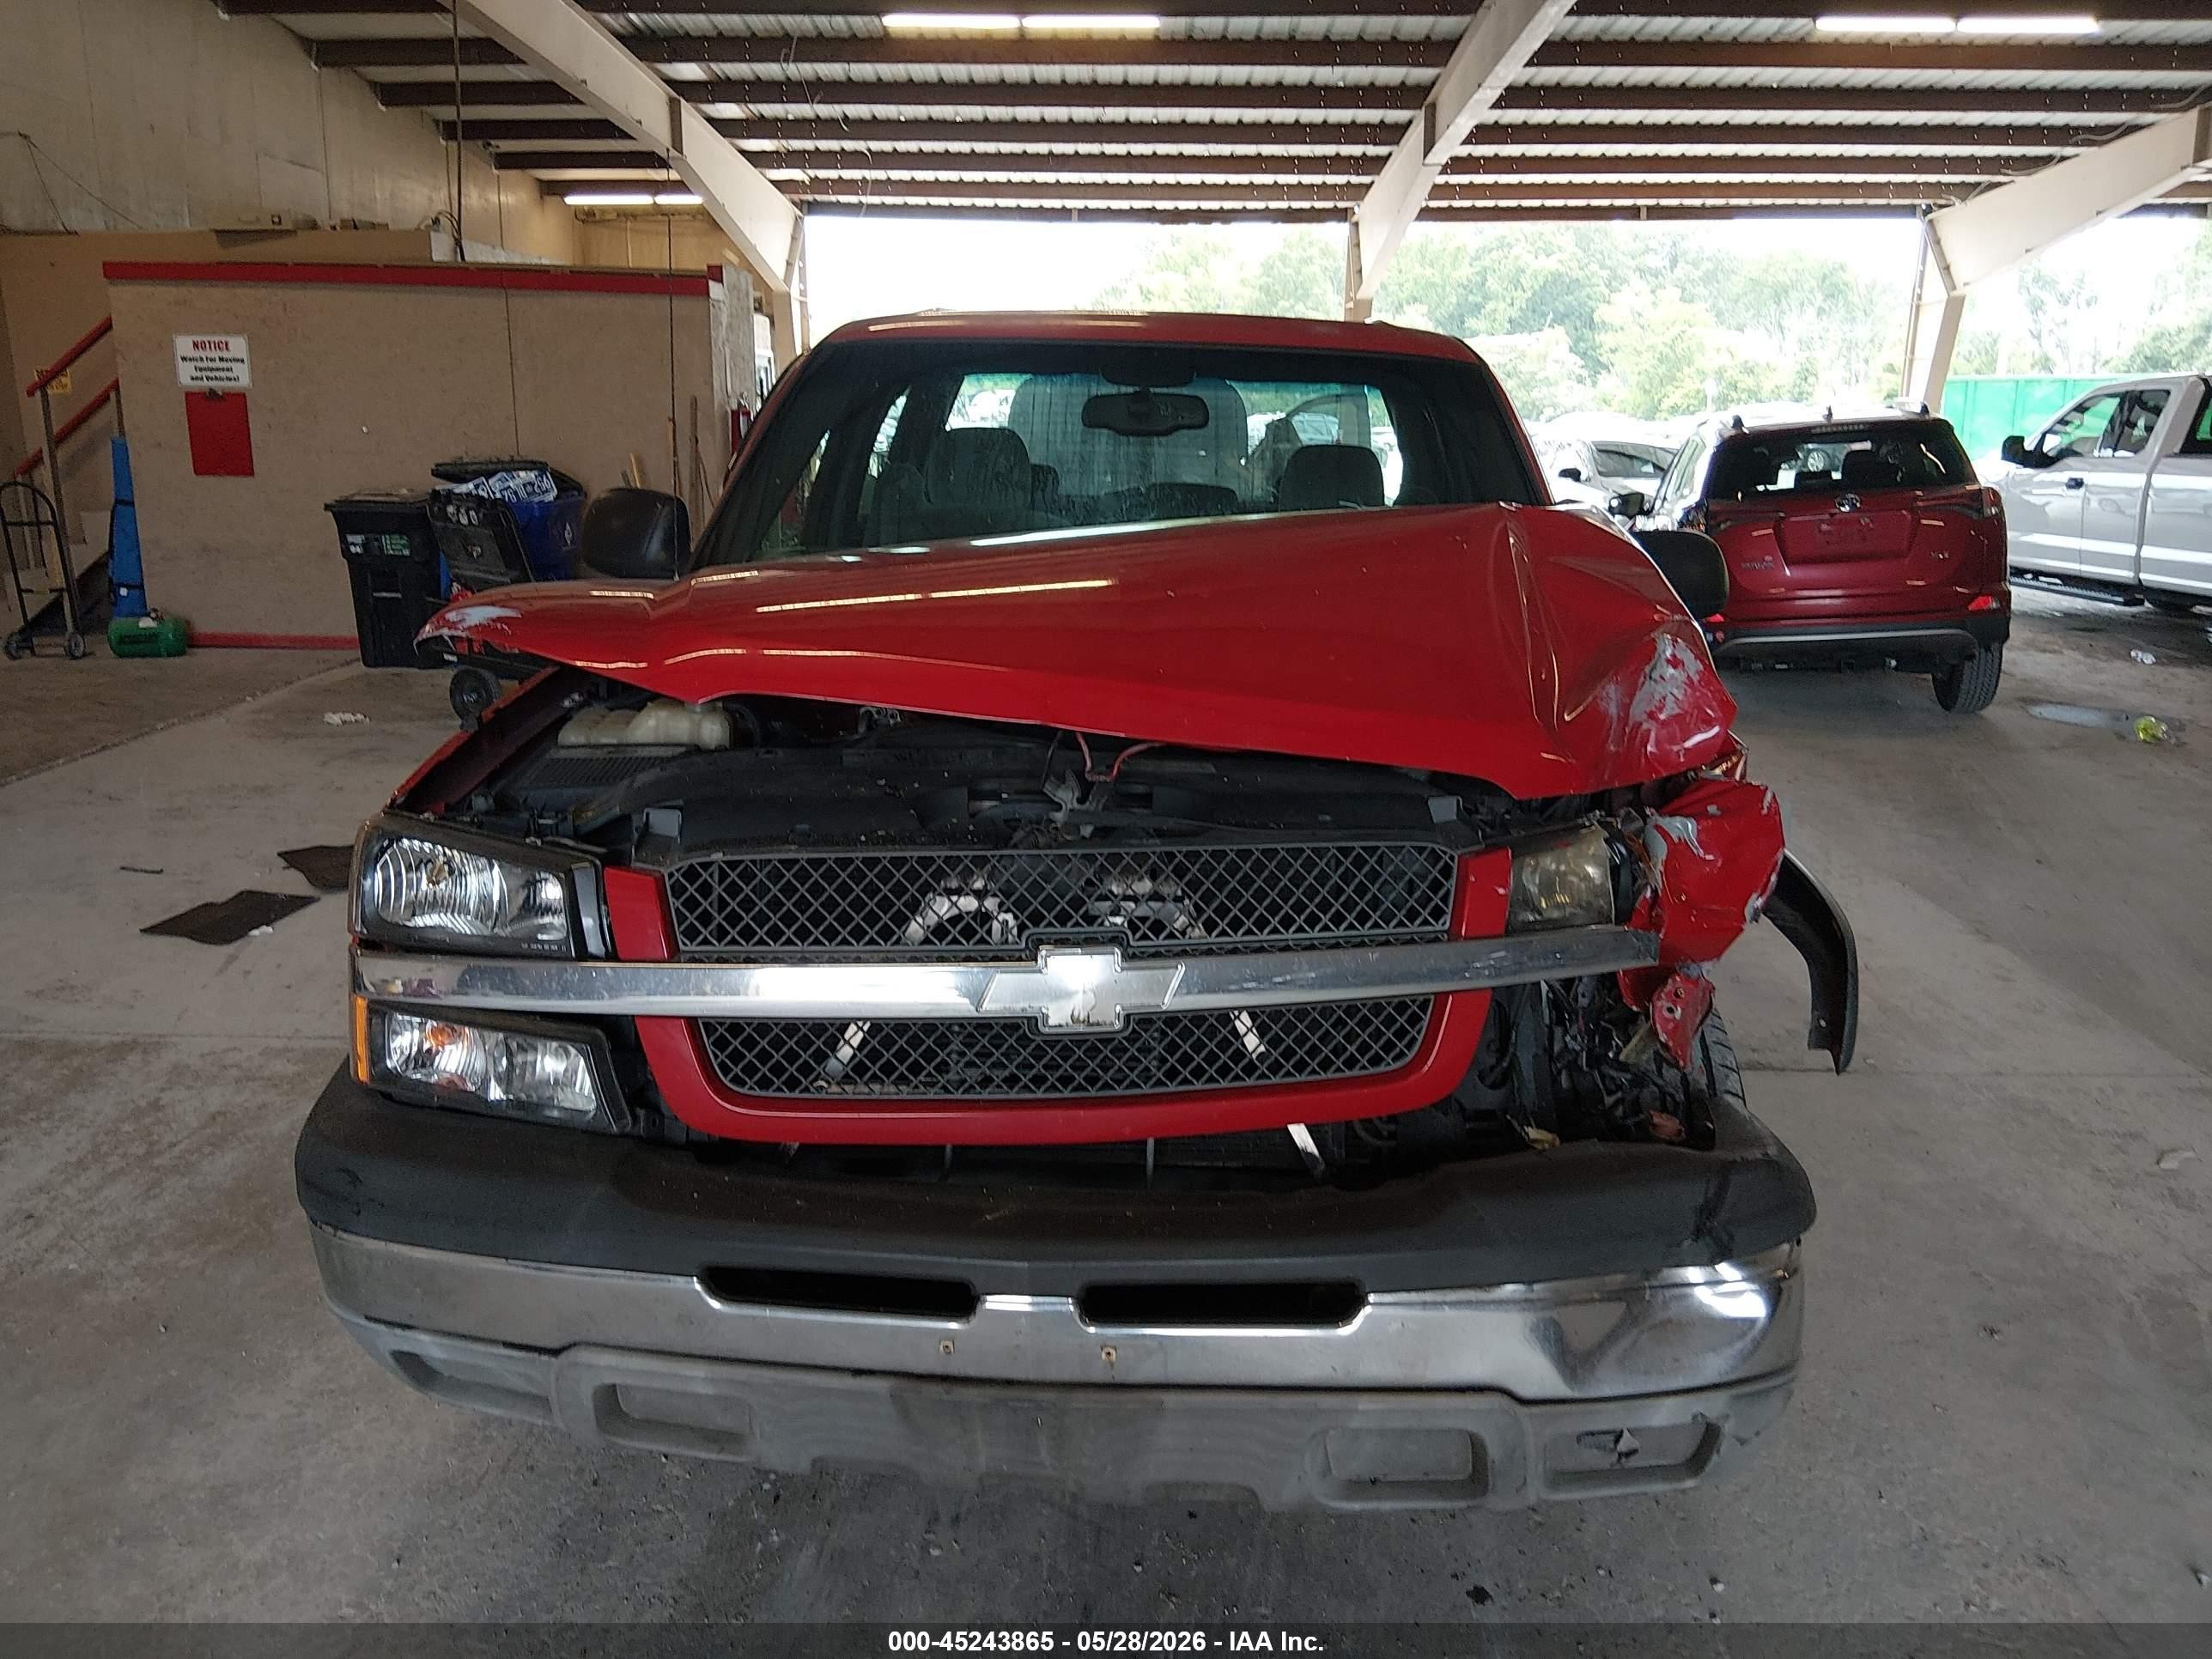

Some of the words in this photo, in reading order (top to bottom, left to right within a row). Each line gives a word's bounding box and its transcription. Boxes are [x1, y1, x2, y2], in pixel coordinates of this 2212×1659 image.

[192, 339, 230, 351] NOTICE
[180, 355, 204, 363] Watch
[218, 356, 246, 364] Moving
[194, 365, 234, 374] Equipment
